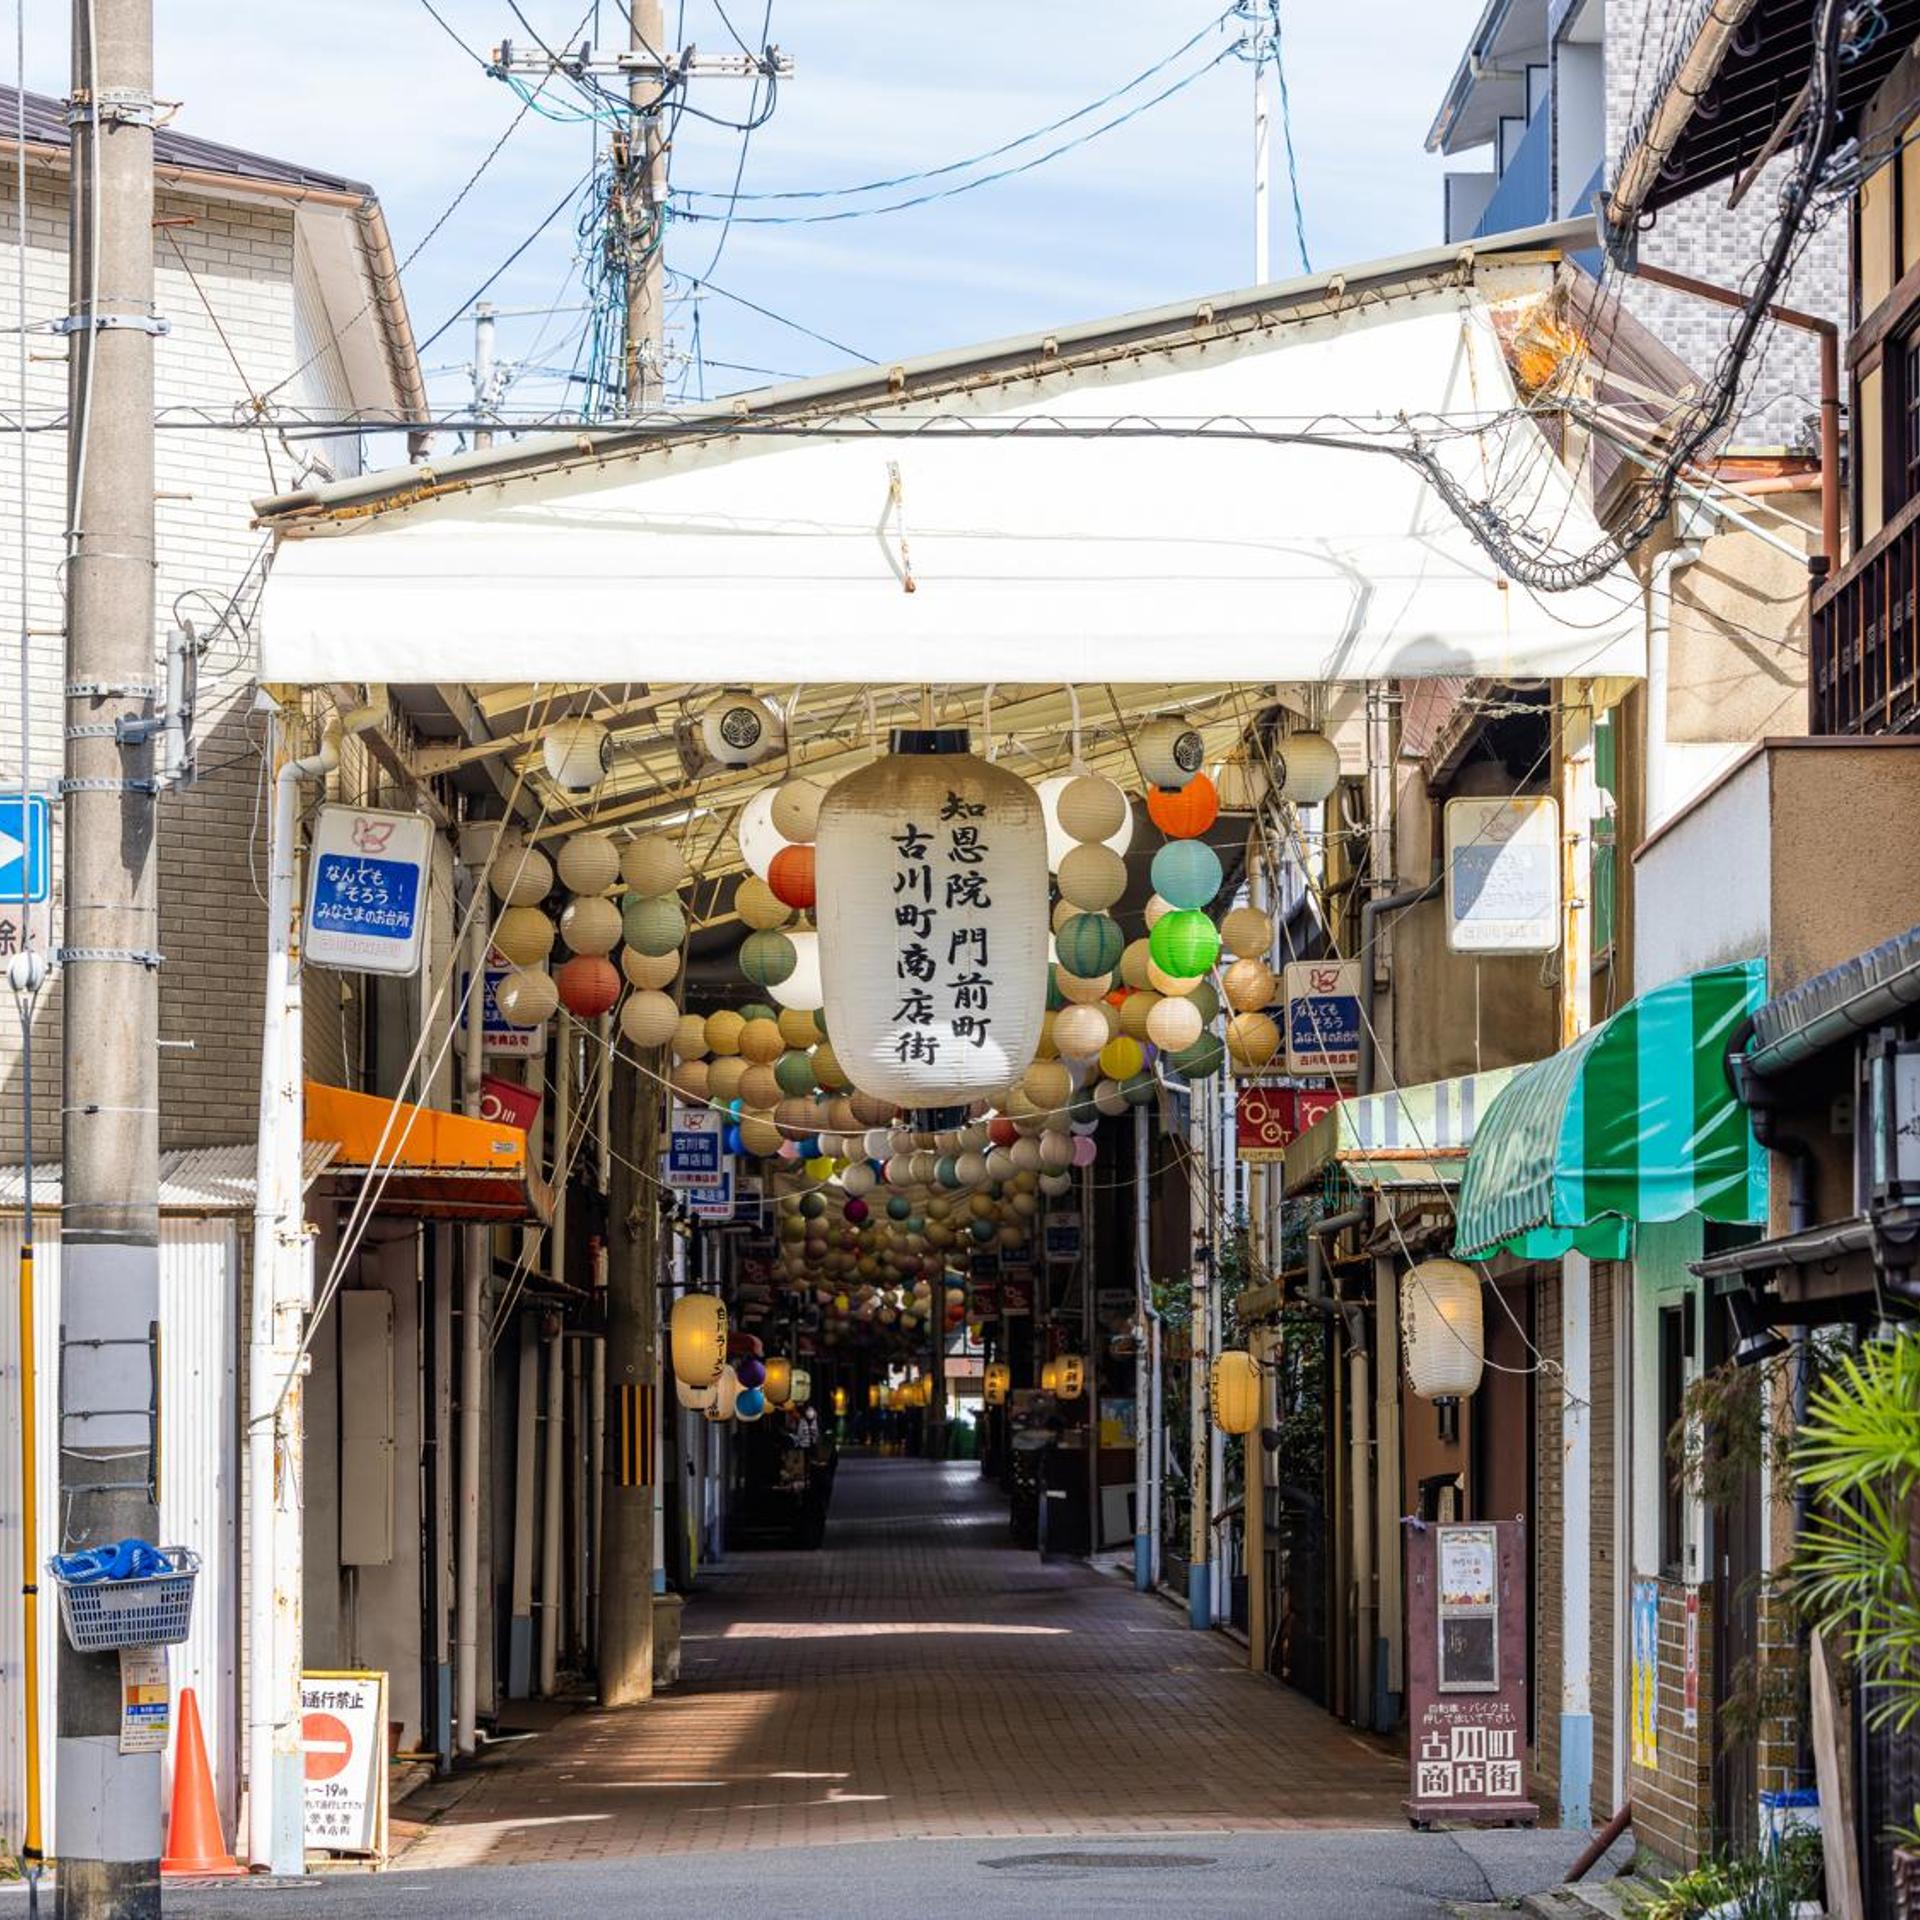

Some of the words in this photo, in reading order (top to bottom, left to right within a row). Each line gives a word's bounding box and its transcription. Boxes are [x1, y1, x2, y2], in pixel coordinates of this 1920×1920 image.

[326, 864, 386, 887] なんでも
[346, 886, 390, 905] そろう
[316, 902, 411, 928] みなさまのお台所
[940, 790, 994, 1048] 知恩院門前町
[890, 822, 941, 1066] 古川町商店街
[1420, 1730, 1518, 1759] 古川町
[1420, 1763, 1519, 1794] 商店街
